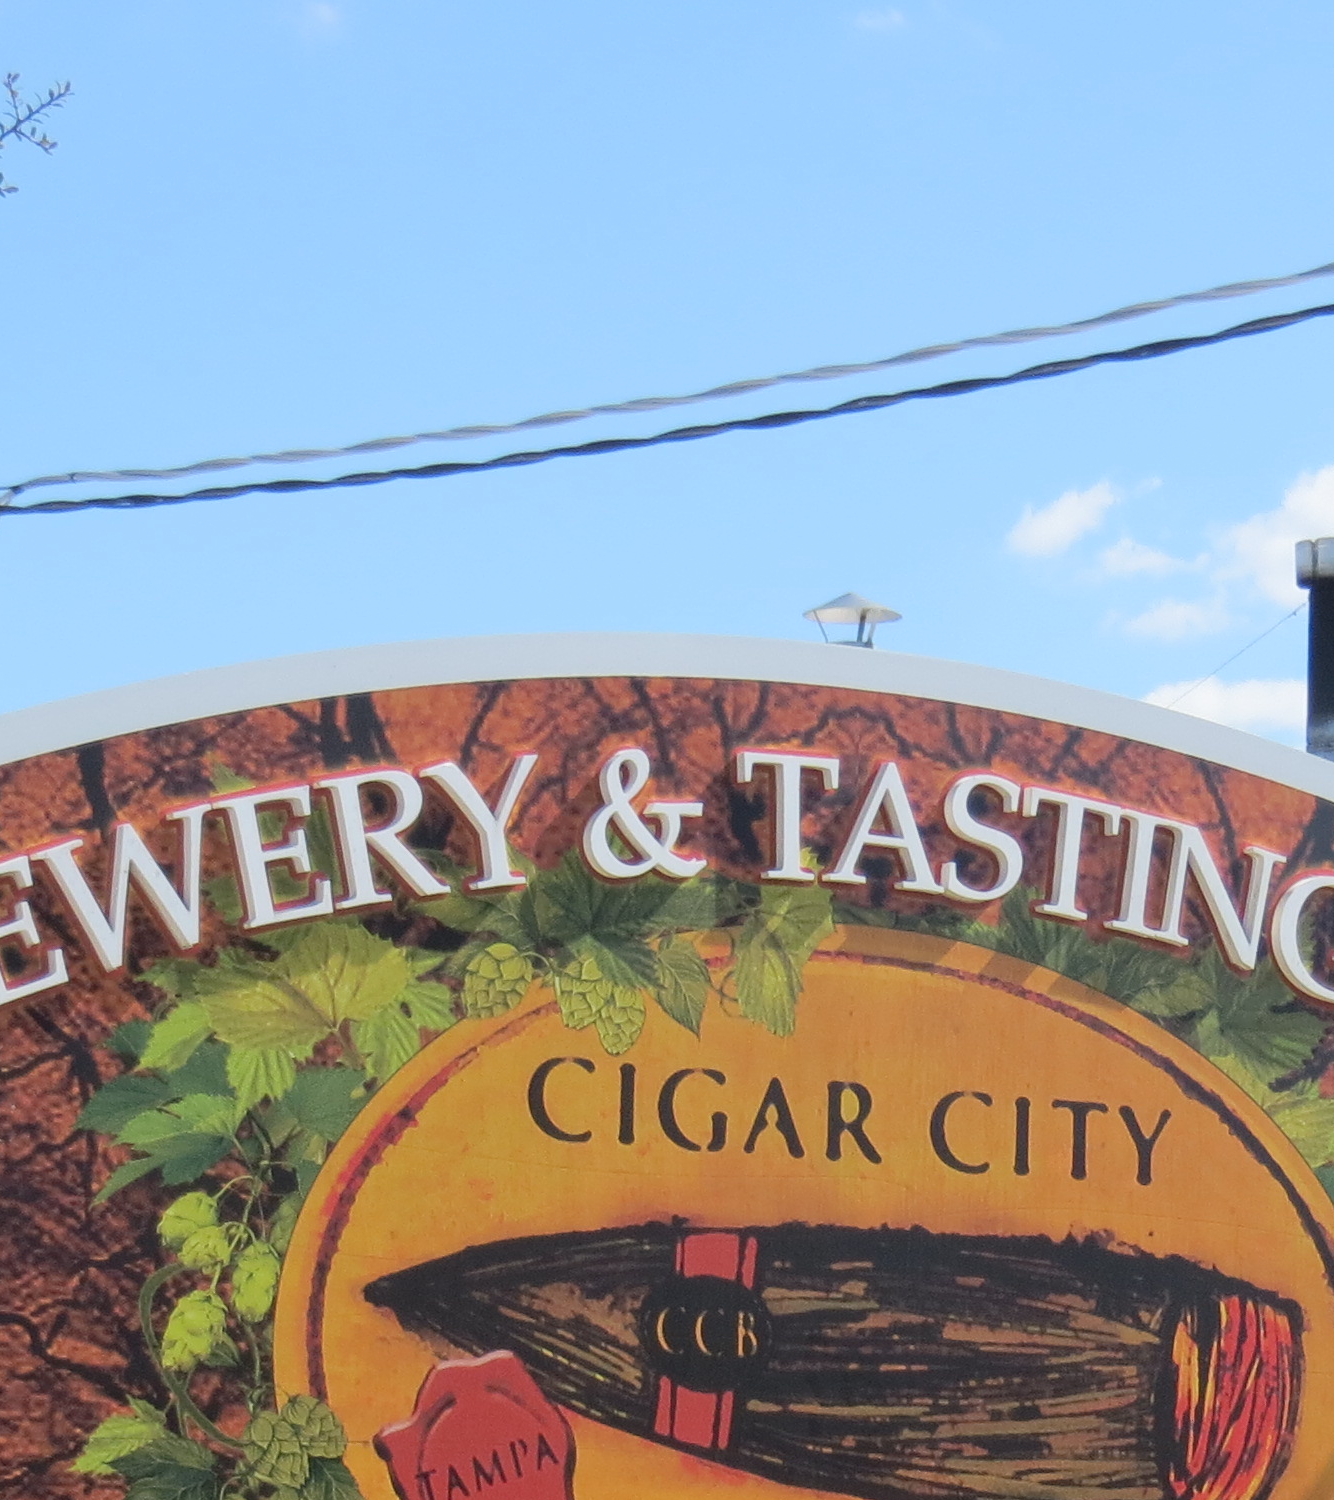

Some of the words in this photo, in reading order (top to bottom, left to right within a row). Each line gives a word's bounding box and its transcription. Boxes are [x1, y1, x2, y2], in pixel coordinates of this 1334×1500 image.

[582, 747, 705, 881] &
[527, 1056, 882, 1163] CIGAR
[929, 1087, 1173, 1186] CITY
[656, 1306, 759, 1358] CCB
